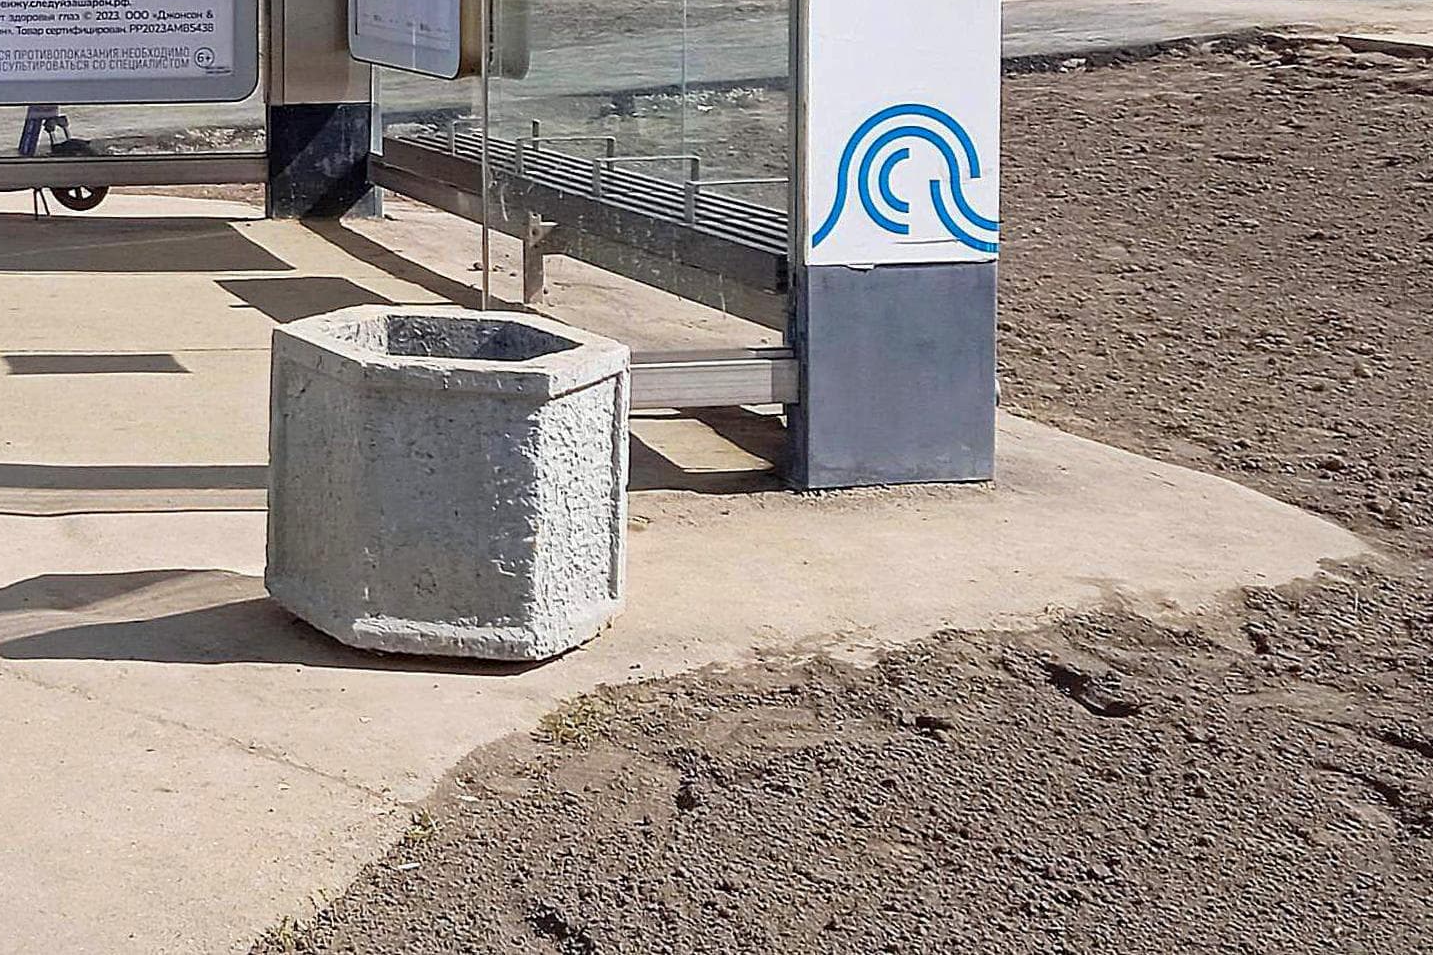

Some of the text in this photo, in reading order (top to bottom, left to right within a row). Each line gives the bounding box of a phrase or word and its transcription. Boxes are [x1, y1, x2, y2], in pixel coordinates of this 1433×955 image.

[58, 13, 81, 21] глаз
[125, 10, 150, 20] ООО
[205, 9, 214, 19] &
[16, 25, 44, 36] Товар
[122, 46, 190, 60] НЕОБХОДИМО
[197, 52, 211, 63] 6+
[92, 59, 106, 70] СО
[109, 58, 190, 70] СПЕЦИАЛИСТОМ
